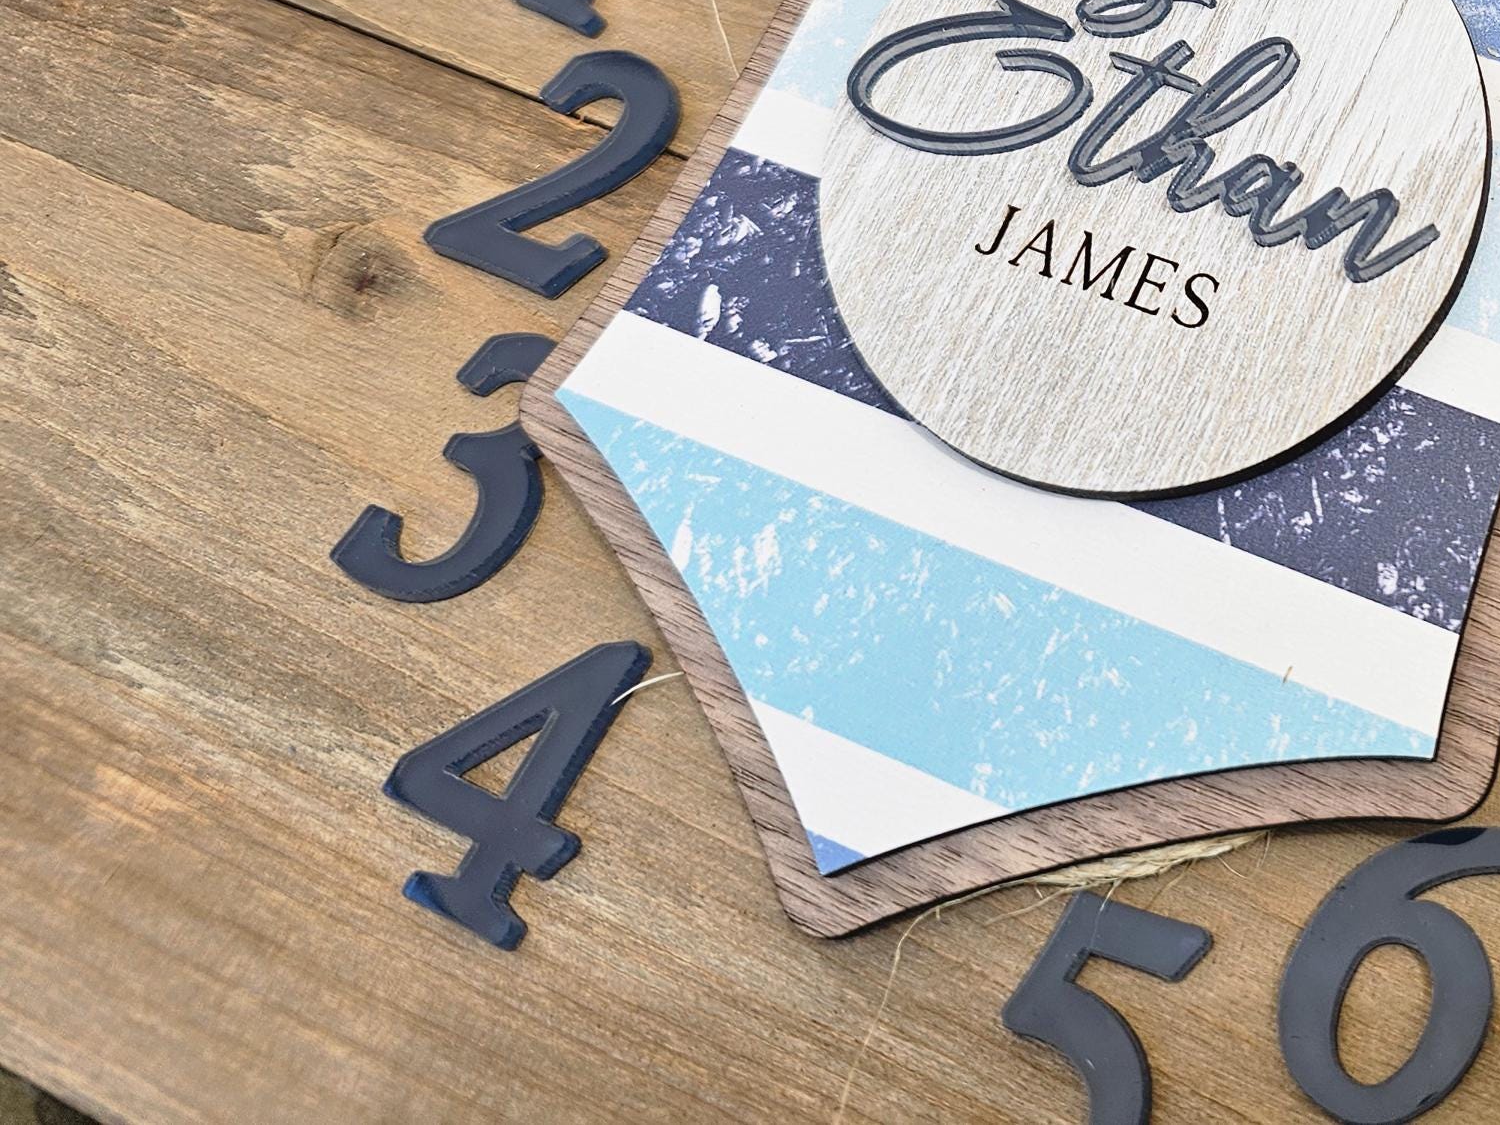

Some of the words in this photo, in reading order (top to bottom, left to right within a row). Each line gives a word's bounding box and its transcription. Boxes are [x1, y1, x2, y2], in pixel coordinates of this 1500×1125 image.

[423, 50, 680, 300] 2
[975, 204, 1220, 328] JAMES
[330, 332, 557, 603] 3
[381, 640, 653, 951] 4
